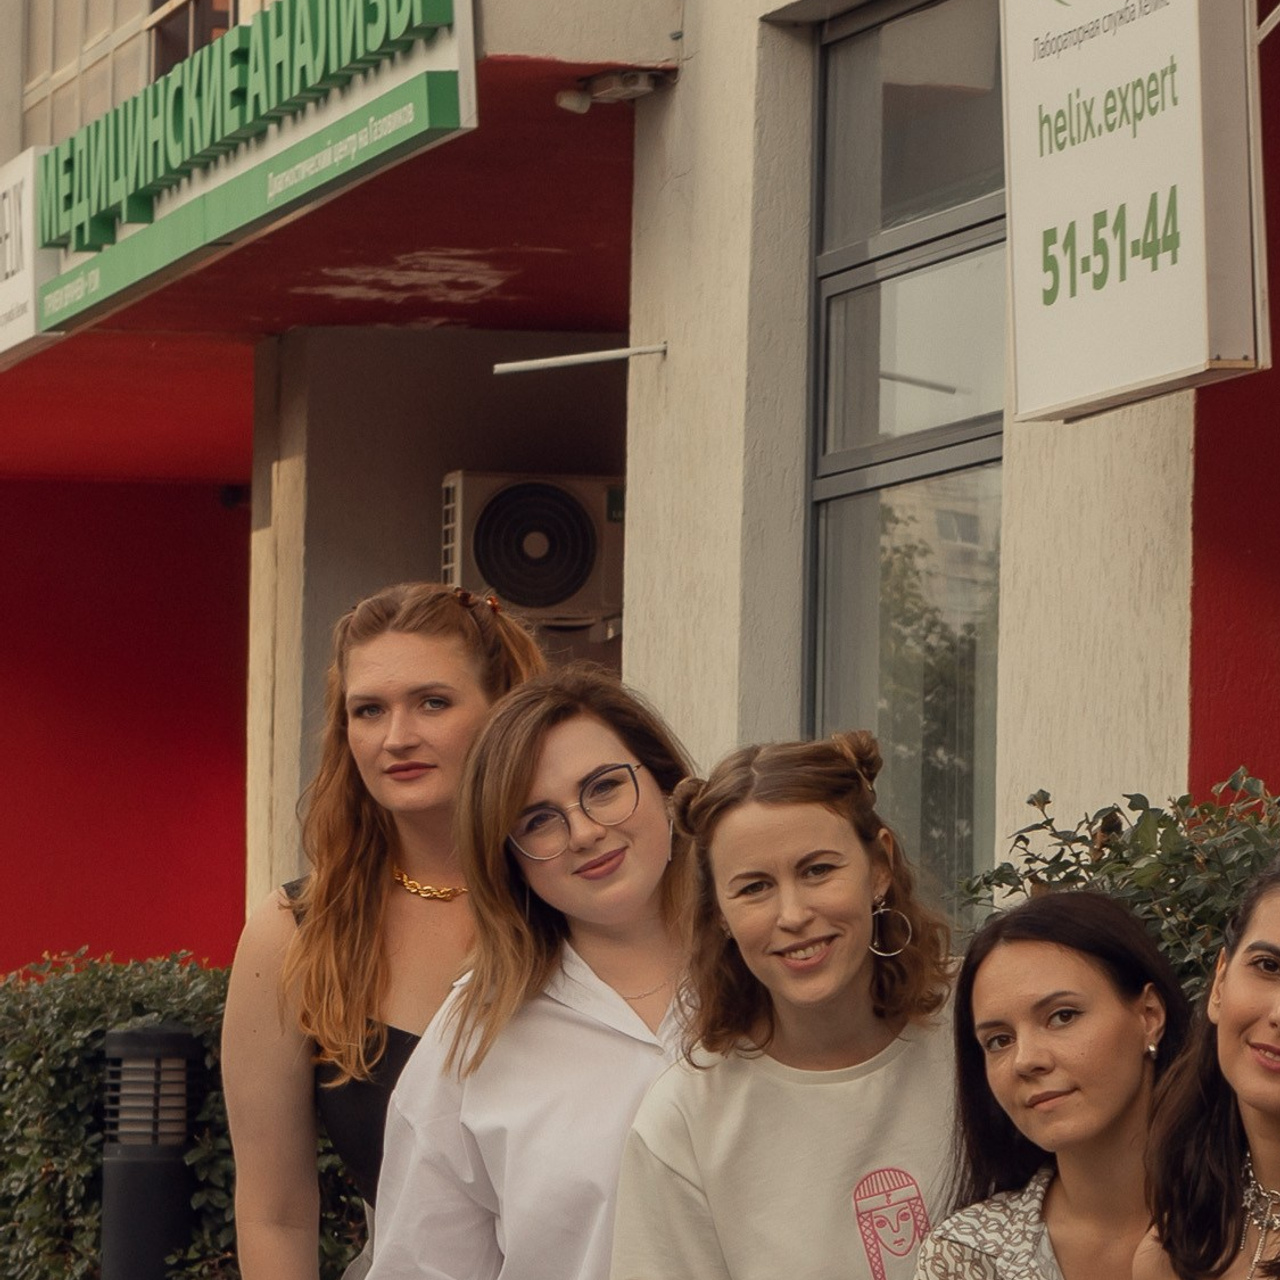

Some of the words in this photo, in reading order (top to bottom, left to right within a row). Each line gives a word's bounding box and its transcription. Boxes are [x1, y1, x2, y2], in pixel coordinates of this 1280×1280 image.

[38, 24, 244, 252] МЕДИЦИНСКИЕ
[246, 0, 424, 124] АНАЛИ
[1038, 55, 1179, 158] helix.expert
[1042, 184, 1180, 306] 51-51-44
